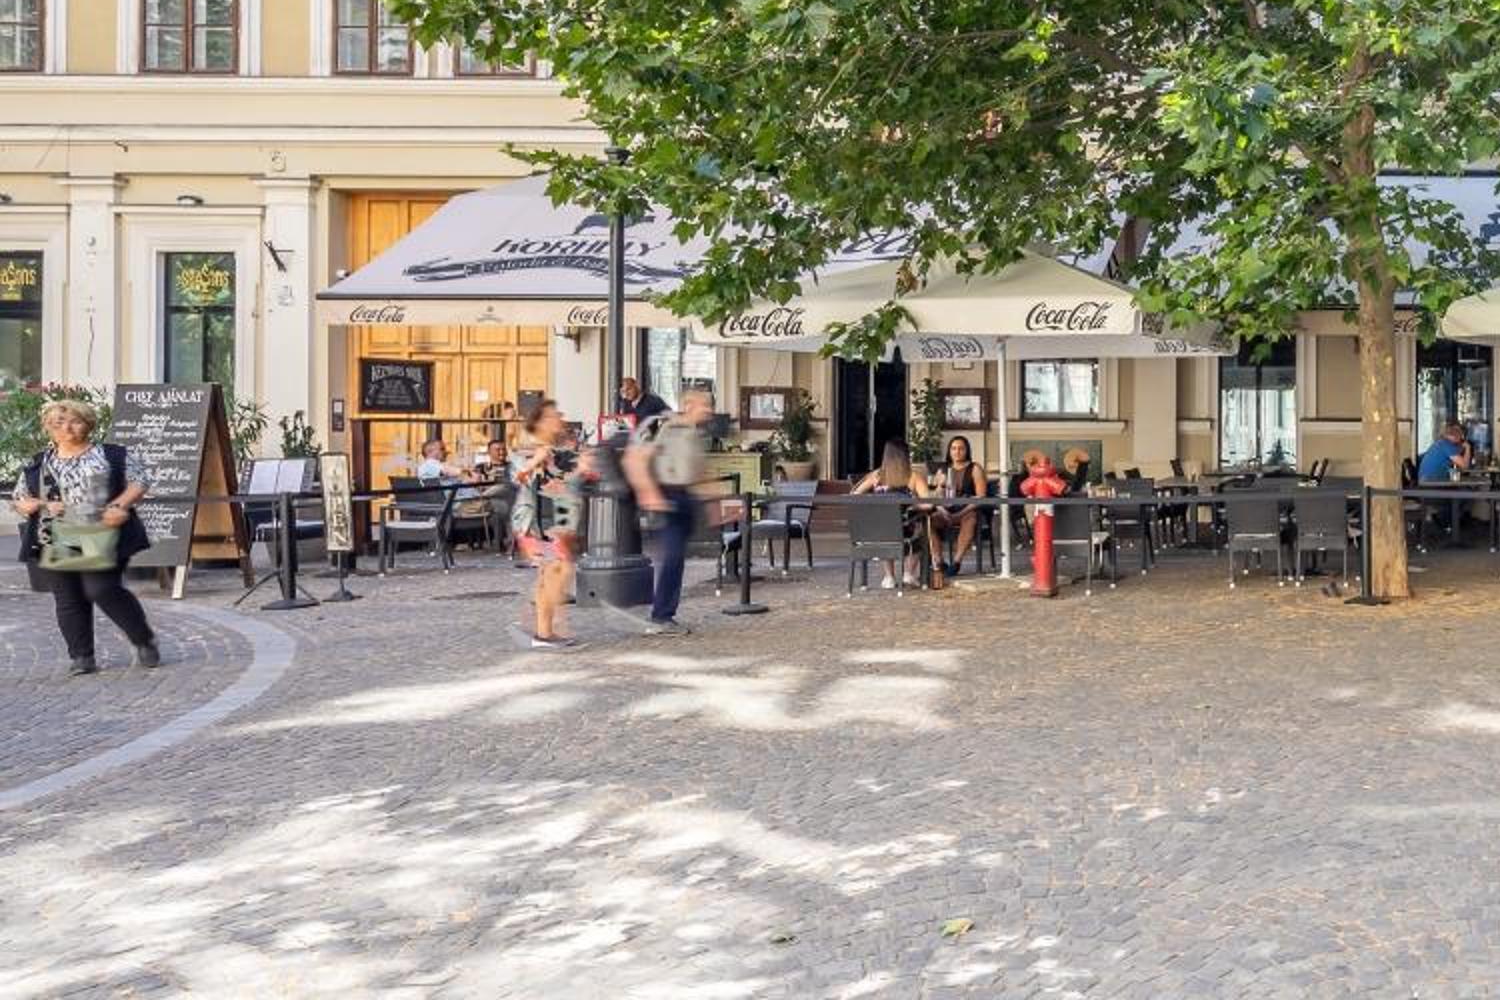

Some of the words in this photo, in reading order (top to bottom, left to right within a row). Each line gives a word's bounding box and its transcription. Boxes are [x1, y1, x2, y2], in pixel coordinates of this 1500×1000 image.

[350, 304, 407, 323] Coca-Cola
[567, 305, 609, 325] Coca-Co
[719, 307, 806, 338] Coca-Cola
[1026, 301, 1114, 331] Coca-Cola
